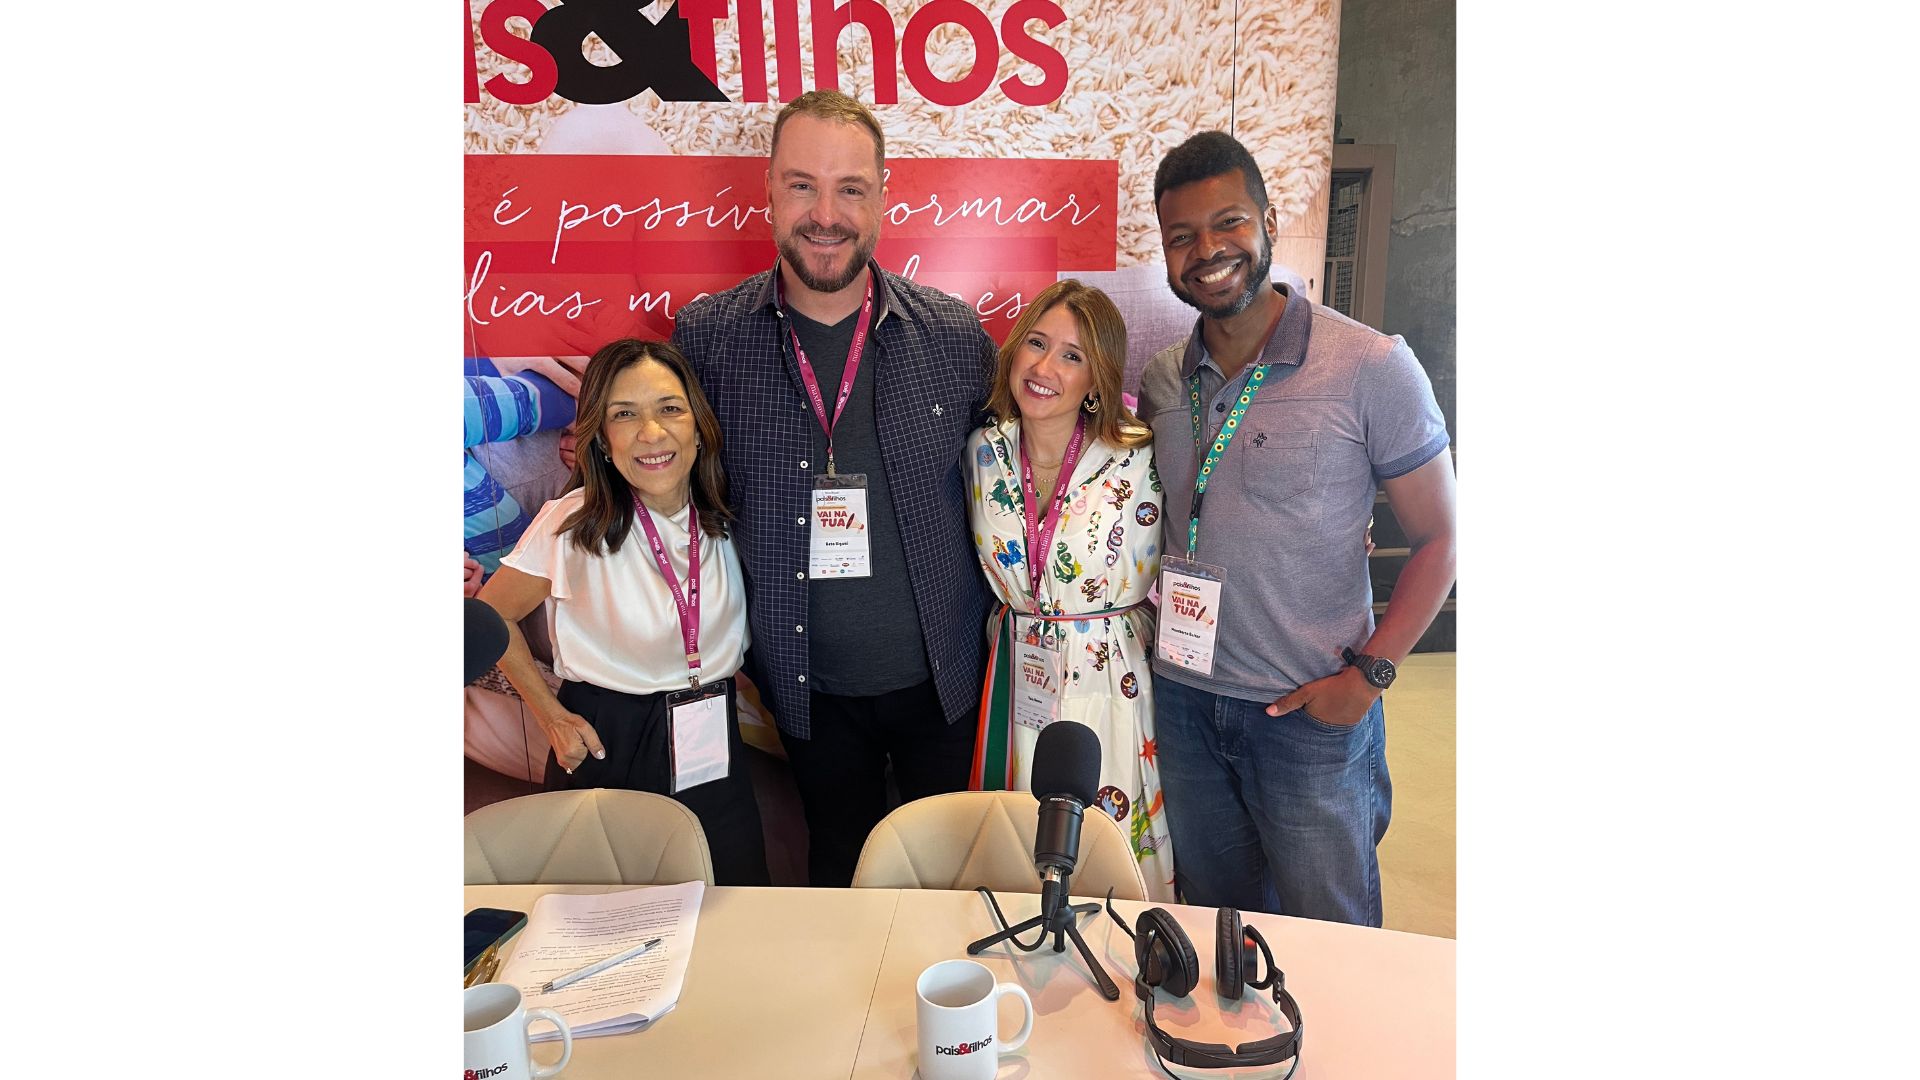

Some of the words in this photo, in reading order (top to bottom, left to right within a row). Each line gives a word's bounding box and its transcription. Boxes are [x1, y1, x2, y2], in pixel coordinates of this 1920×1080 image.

[493, 186, 532, 226] é
[884, 168, 1101, 226] ormar
[820, 518, 846, 528] TUA
[1171, 595, 1185, 604] VAI
[1187, 599, 1199, 608] NA
[1174, 604, 1196, 618] TUA
[1023, 665, 1034, 674] VAI
[1035, 669, 1044, 678] NA
[1025, 674, 1042, 686] TUA
[935, 1034, 993, 1056] pais&filhos
